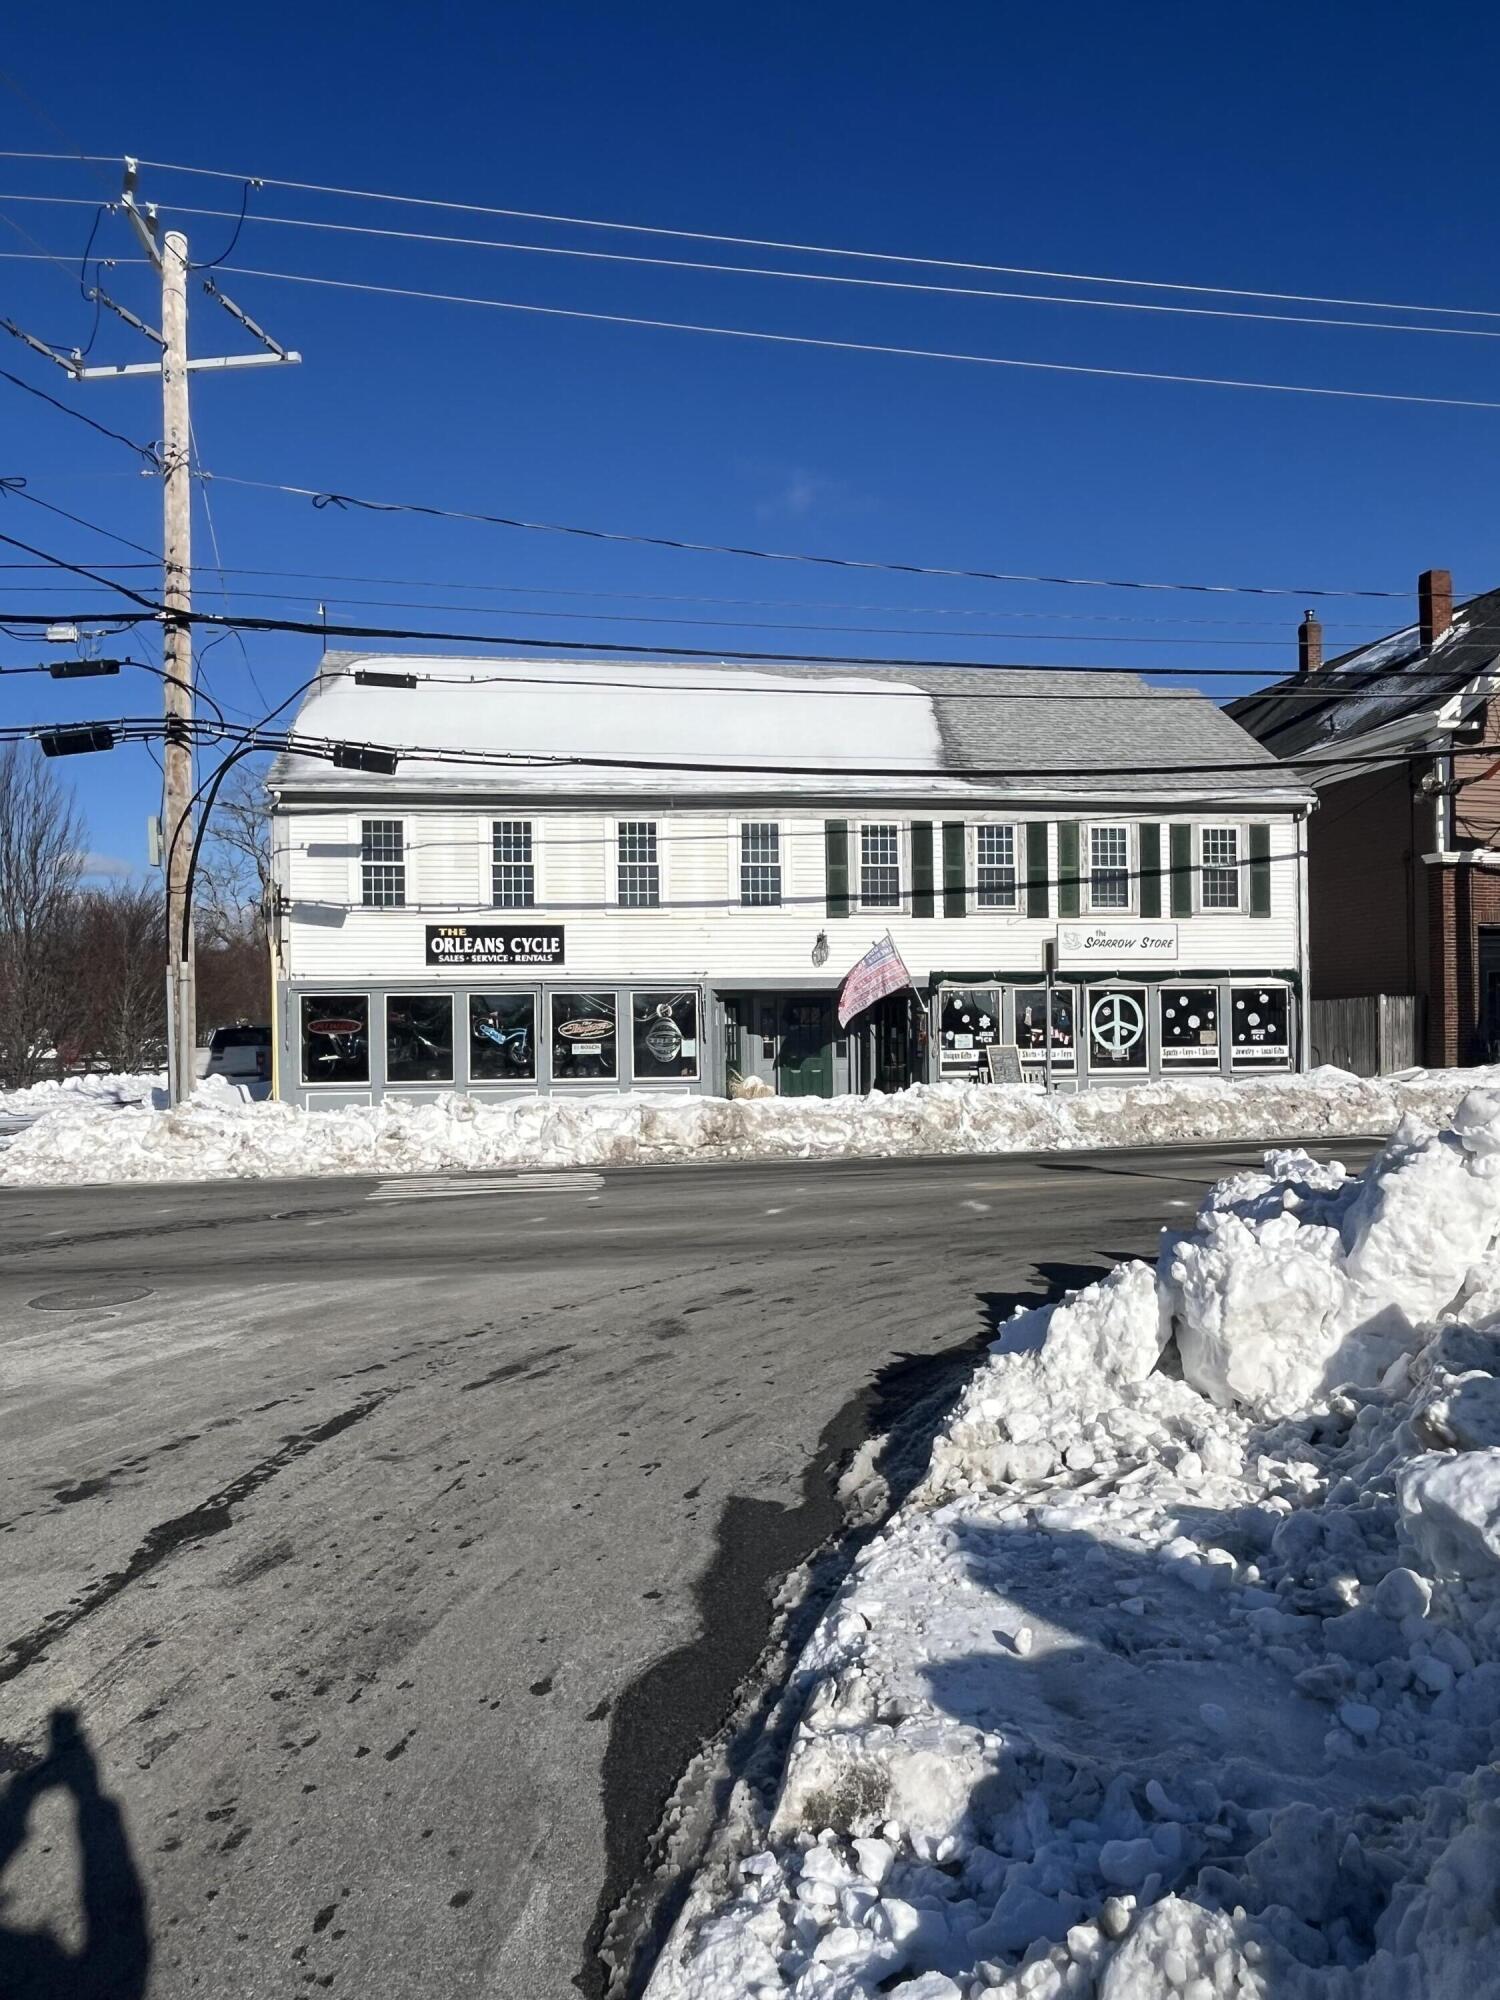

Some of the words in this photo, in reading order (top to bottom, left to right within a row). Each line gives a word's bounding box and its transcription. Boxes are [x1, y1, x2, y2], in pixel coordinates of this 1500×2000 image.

[438, 928, 467, 936] THE
[431, 937, 505, 953] ORLEANS
[510, 937, 560, 953] CYCLE
[438, 954, 465, 962] SALES
[471, 954, 508, 962] SERVICE
[515, 954, 553, 962] RENTALS
